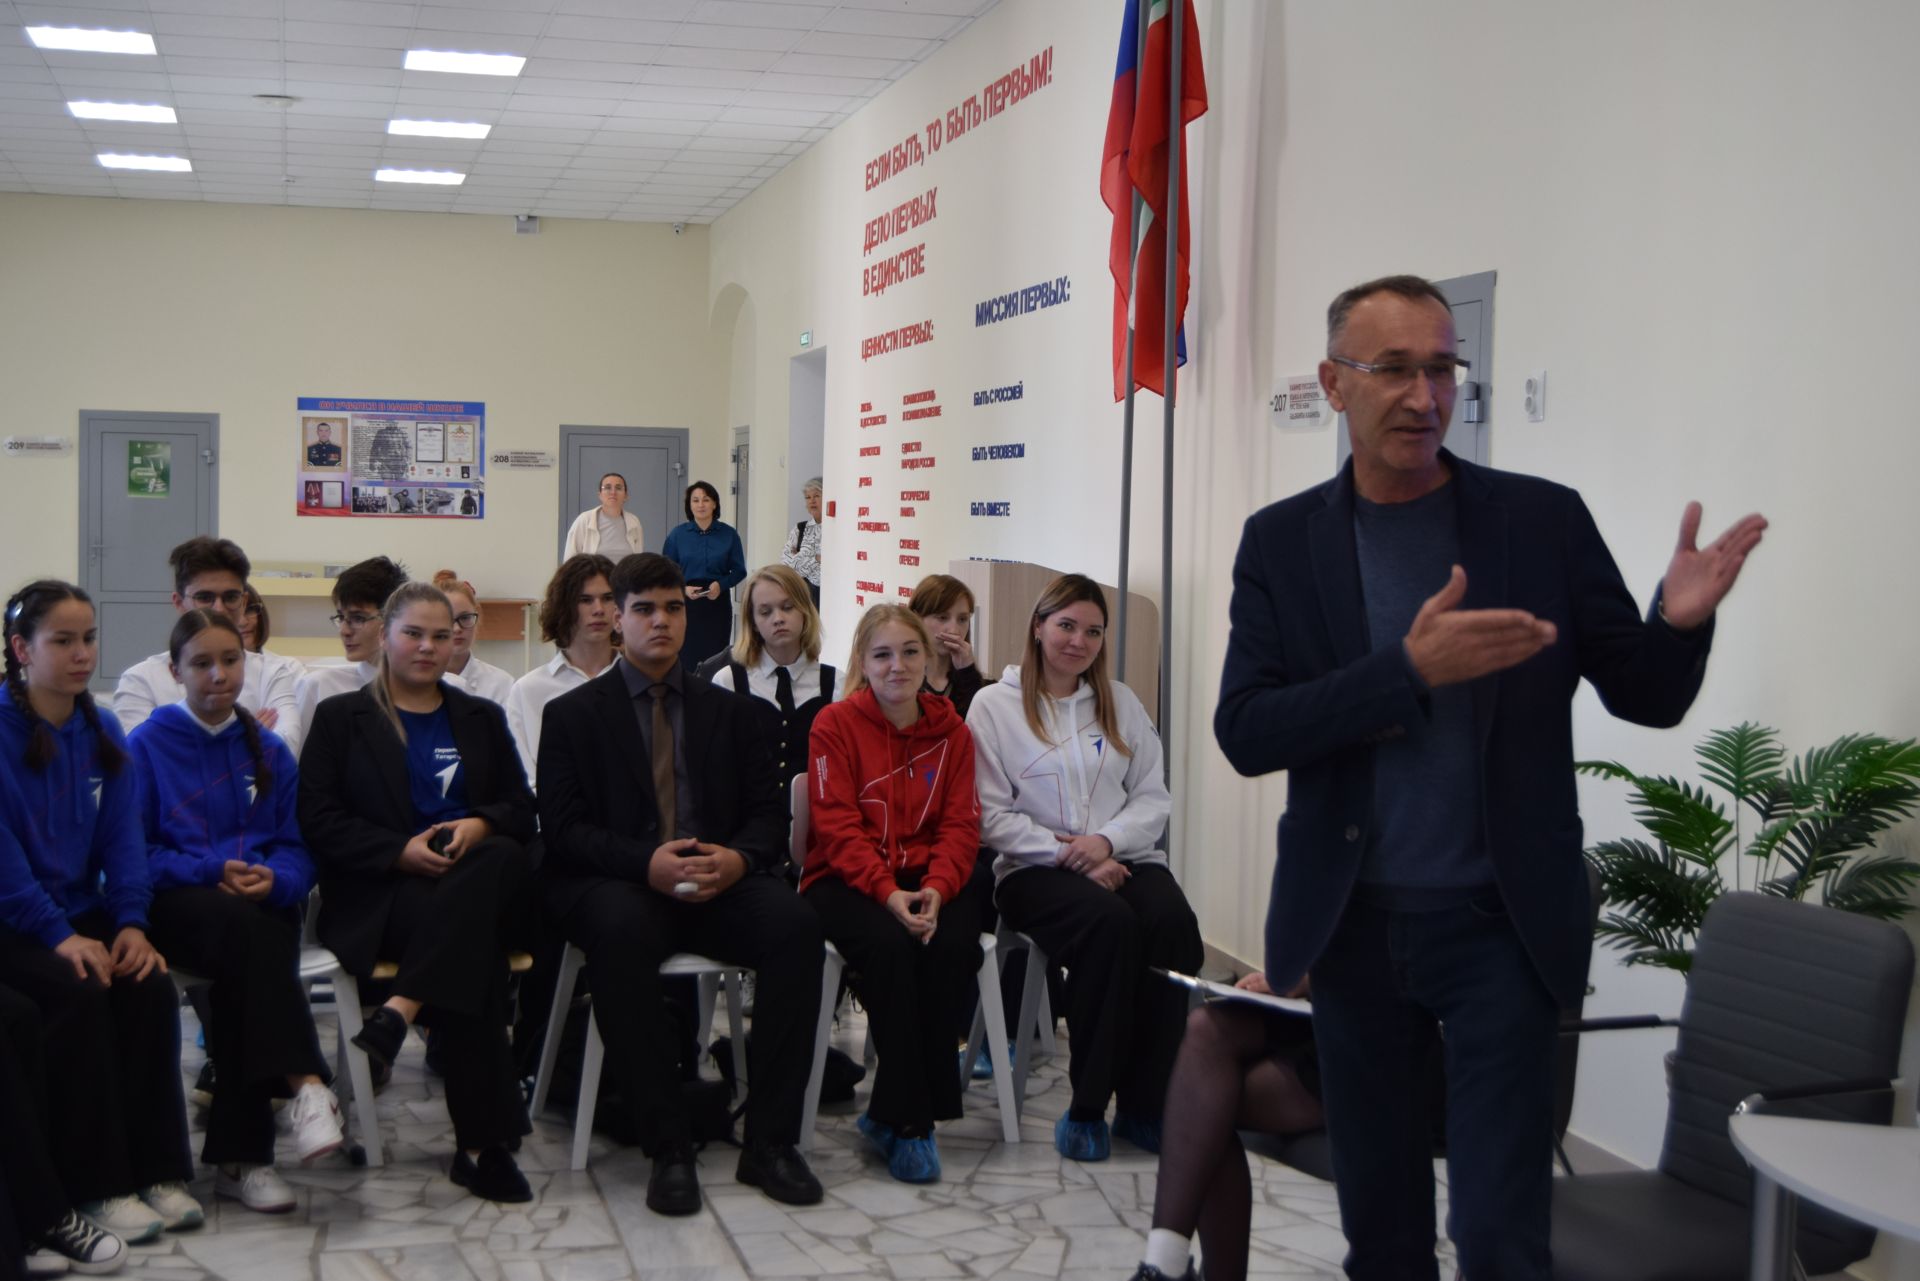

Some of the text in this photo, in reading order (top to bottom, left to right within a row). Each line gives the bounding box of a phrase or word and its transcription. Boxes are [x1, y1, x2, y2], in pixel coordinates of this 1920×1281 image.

[865, 46, 1053, 192] ЕСЛИ БЫТЬ, ТО БЫТЬ ПЕРВЫМ!
[863, 187, 938, 257] ДЕЛО ПЕРВЫХ
[863, 243, 926, 297] В ЕДИНСТВЕ
[976, 275, 1070, 328] МИССИЯ ПЕРВЫХ:
[862, 319, 934, 362] ЦЕННОСТИ ПЕРВЫХ:
[974, 390, 989, 406] БЫТЬ
[995, 381, 1023, 402] РОССИЕЙ
[1274, 394, 1287, 412] 207
[8, 441, 25, 450] 209
[972, 443, 1025, 461] БЫТЬ ЧЕЛОВЕКОМ
[494, 455, 509, 463] 208
[971, 502, 1011, 517] БЫТЬ ВМЕСТЕ
